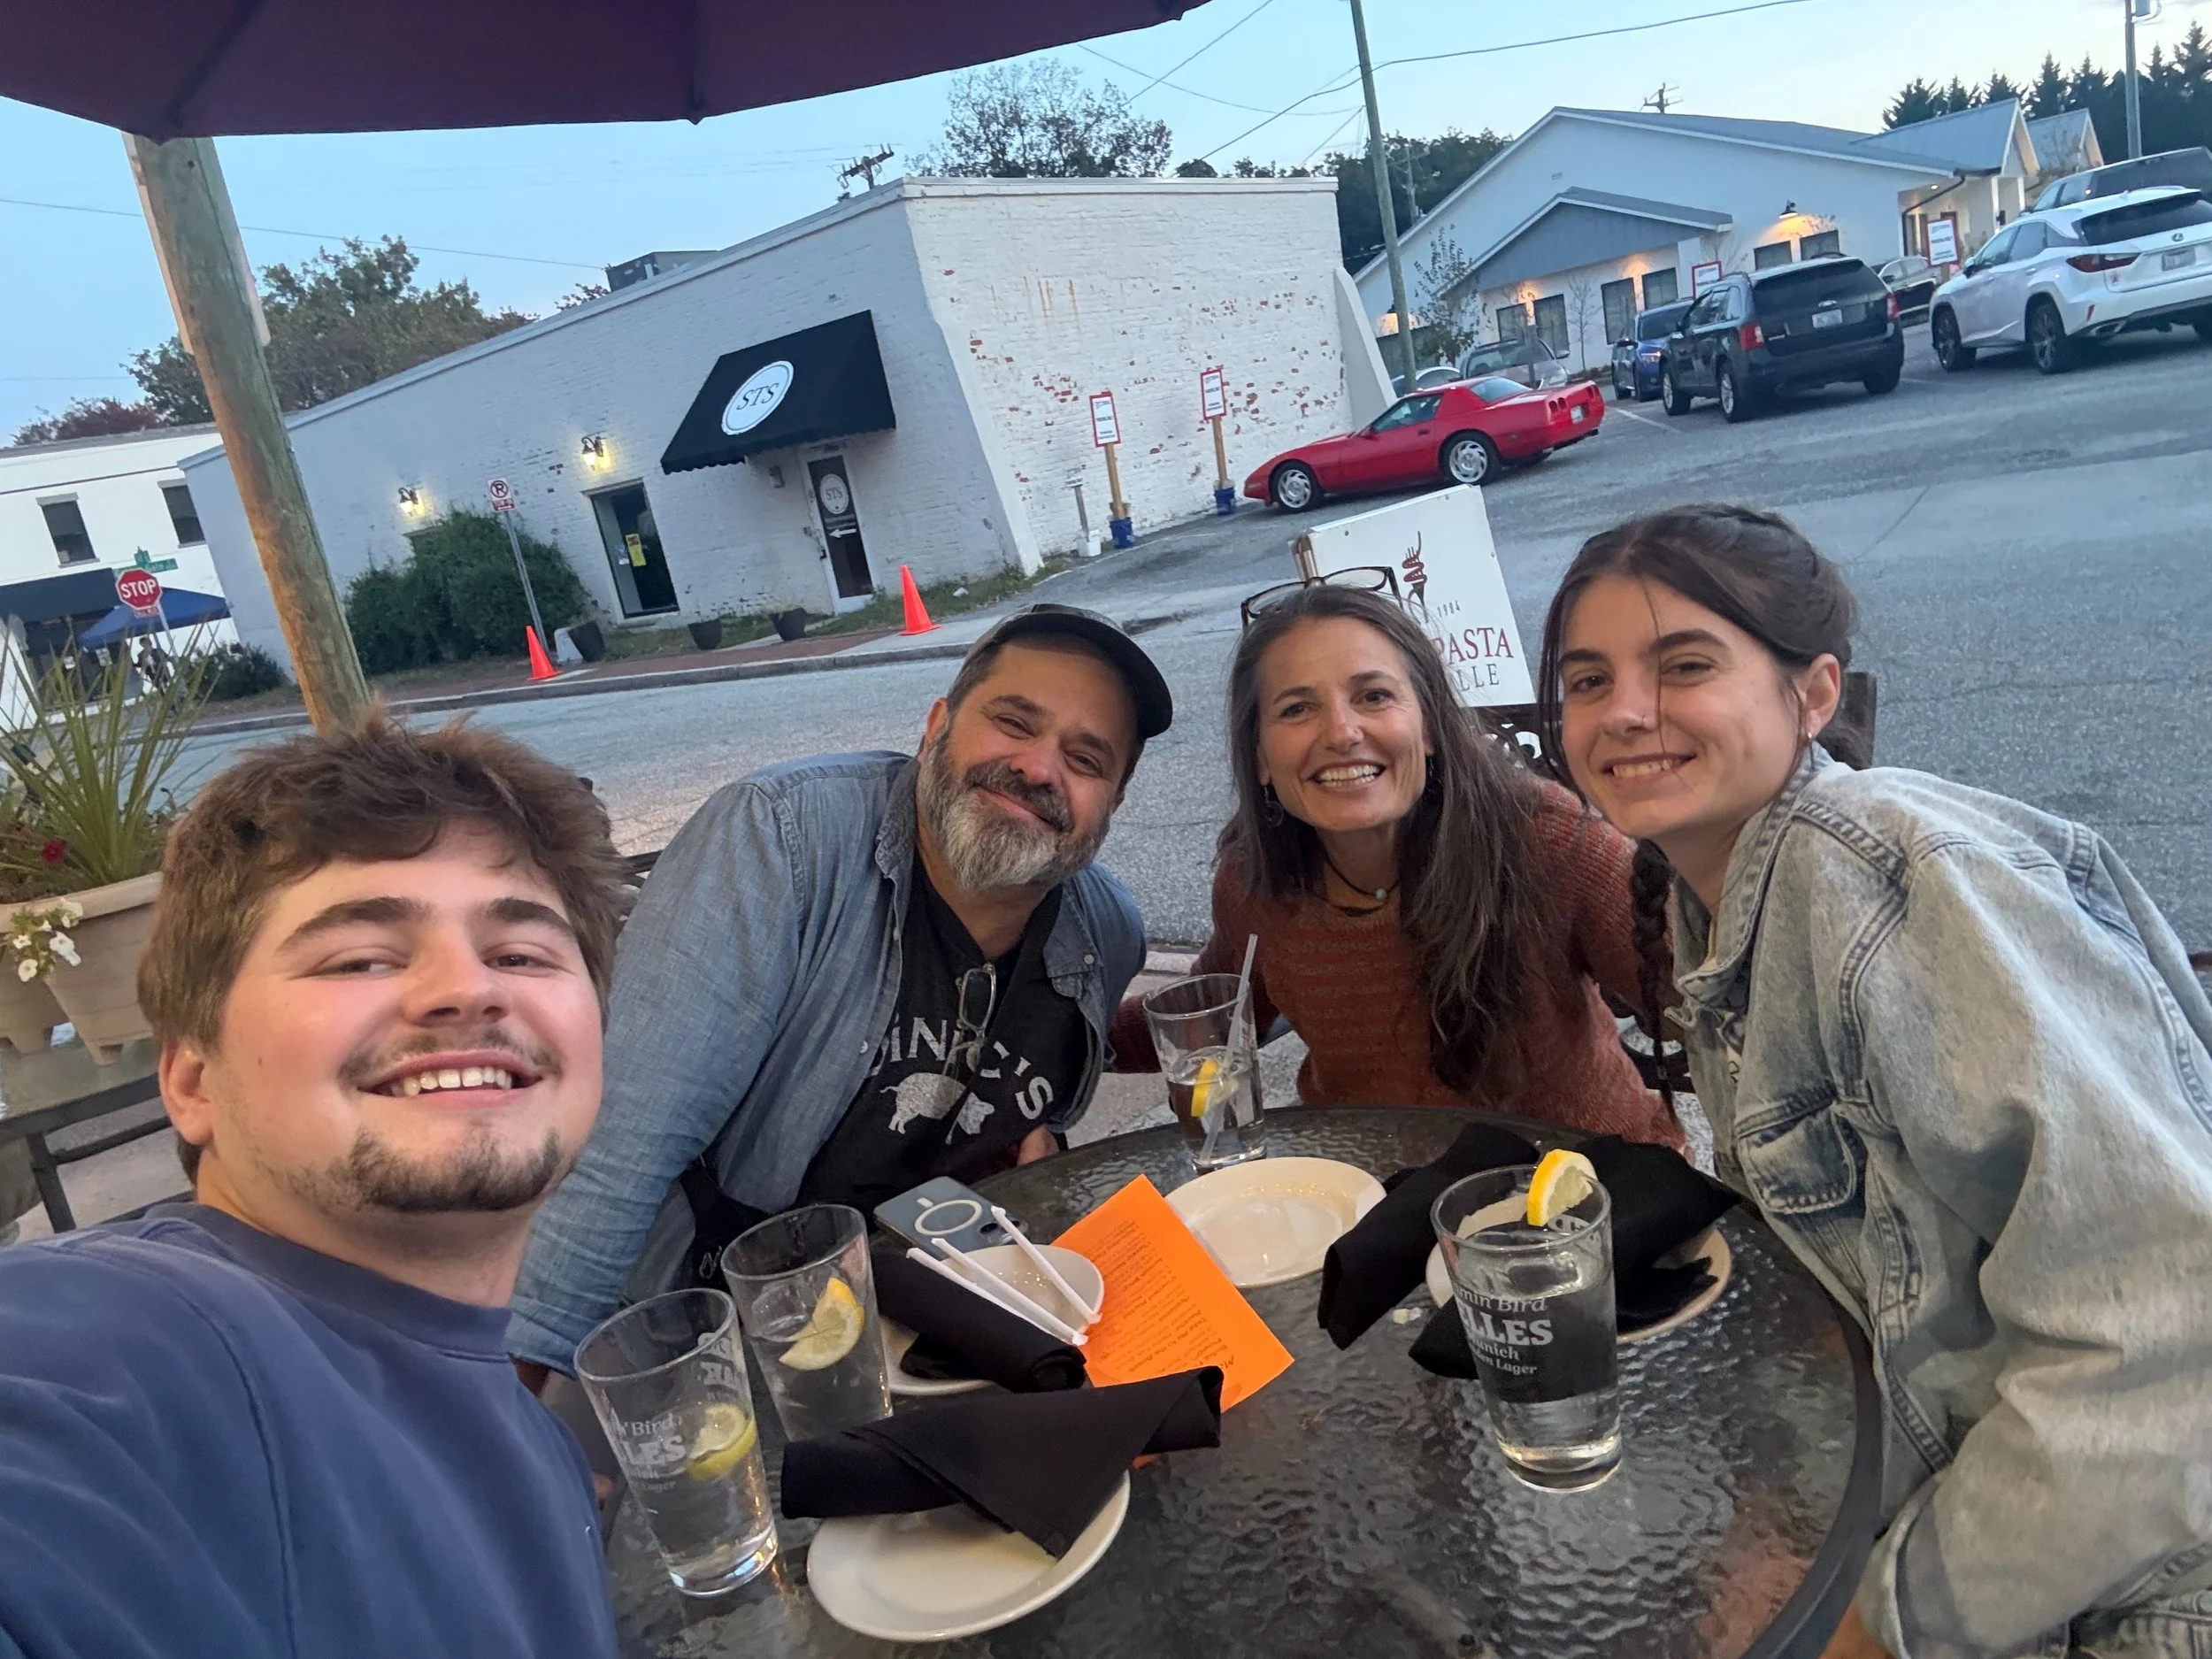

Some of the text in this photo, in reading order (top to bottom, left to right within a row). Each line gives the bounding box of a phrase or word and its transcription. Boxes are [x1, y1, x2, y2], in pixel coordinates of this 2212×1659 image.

[736, 382, 780, 411] STS
[825, 486, 843, 501] STS
[120, 579, 156, 598] STOP
[1456, 663, 1500, 692] LLE
[1496, 1295, 1547, 1313] Bird
[1496, 1358, 1538, 1376] Lager
